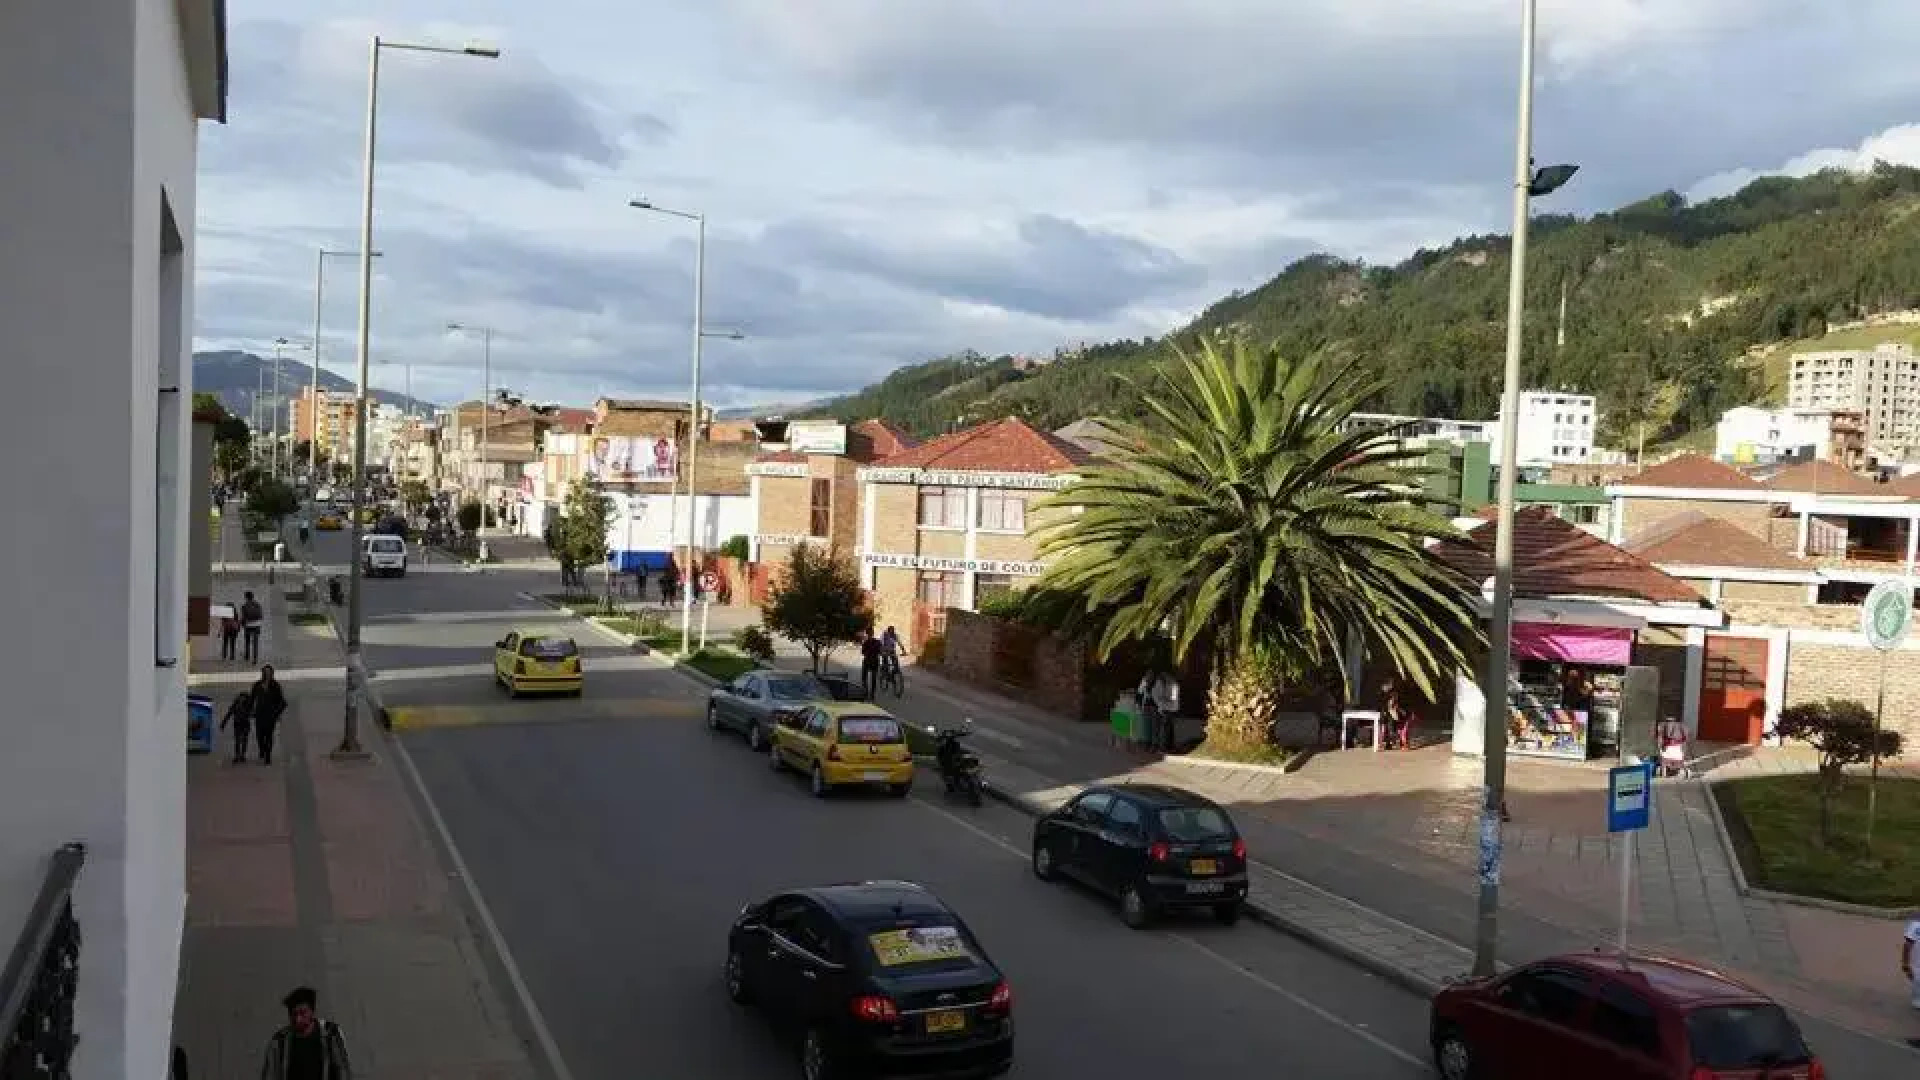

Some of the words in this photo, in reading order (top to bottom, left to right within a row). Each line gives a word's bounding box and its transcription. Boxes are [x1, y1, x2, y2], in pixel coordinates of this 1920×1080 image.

[937, 474, 952, 485] DE
[957, 475, 994, 486] PAULA
[865, 555, 897, 565] PARA
[902, 557, 919, 567] EL
[922, 559, 977, 571] FUTURO
[981, 561, 996, 571] DE
